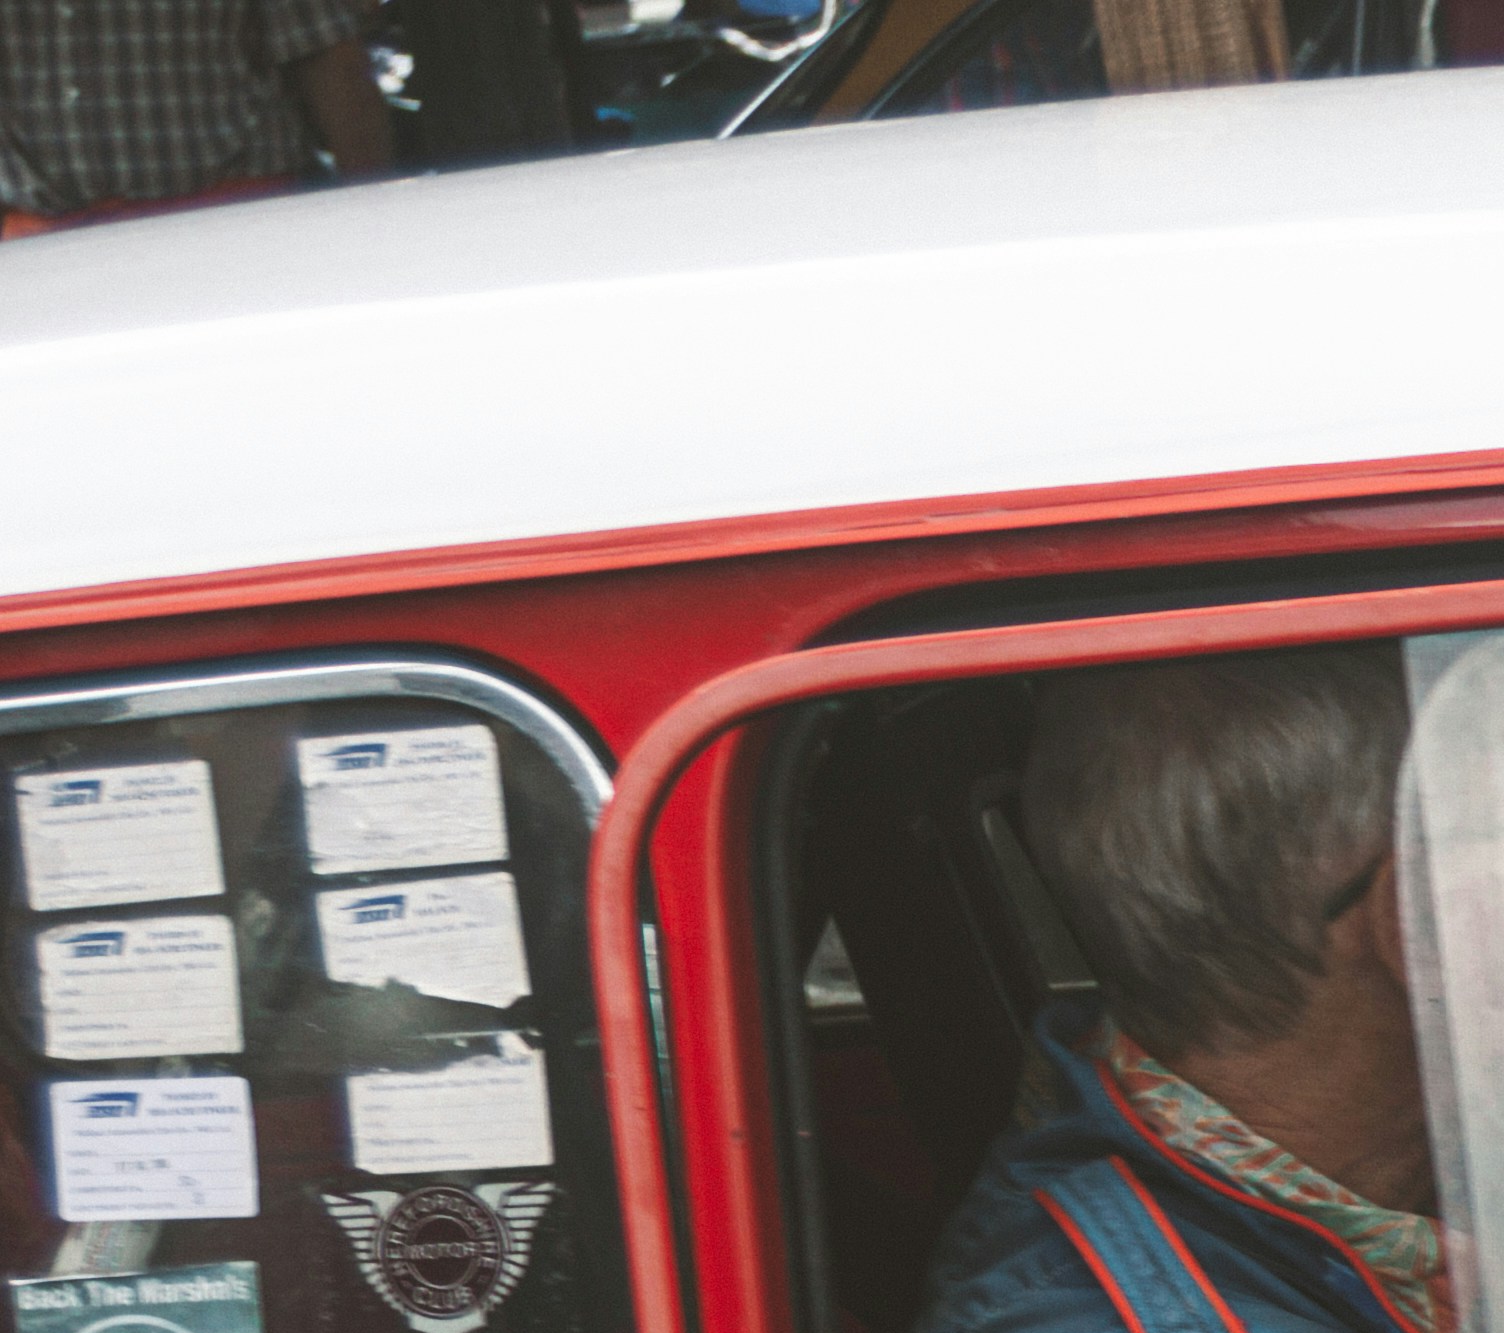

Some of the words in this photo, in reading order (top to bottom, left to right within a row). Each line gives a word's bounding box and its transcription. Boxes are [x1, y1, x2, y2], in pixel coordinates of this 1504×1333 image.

[16, 1285, 83, 1311] Back
[82, 1279, 137, 1307] The
[412, 1284, 474, 1311] CLUB
